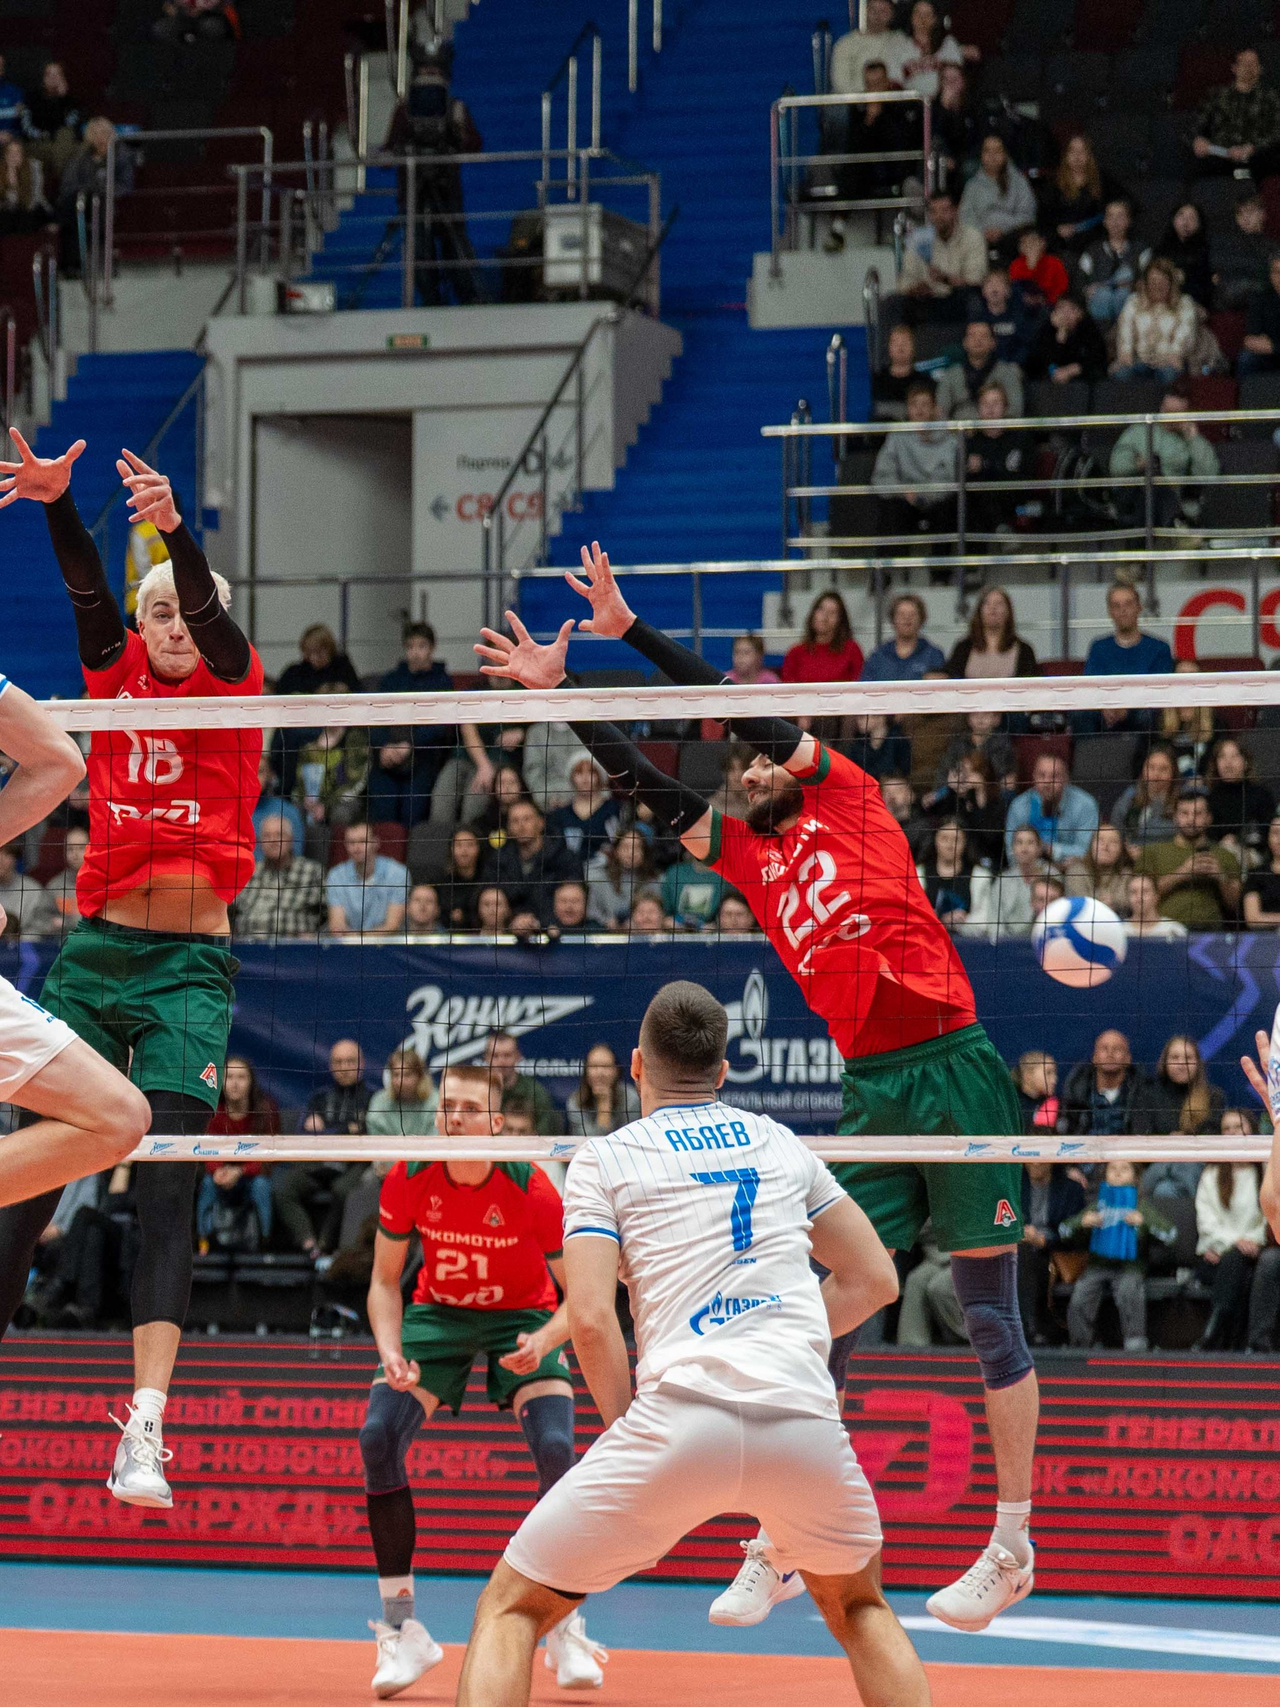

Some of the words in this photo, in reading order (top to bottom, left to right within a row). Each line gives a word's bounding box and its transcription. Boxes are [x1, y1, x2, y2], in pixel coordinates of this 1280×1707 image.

[124, 730, 184, 785] 18
[776, 850, 852, 951] 22
[665, 1121, 751, 1152] АБАЕВ
[689, 1167, 761, 1252] 7
[435, 1248, 489, 1282] 21
